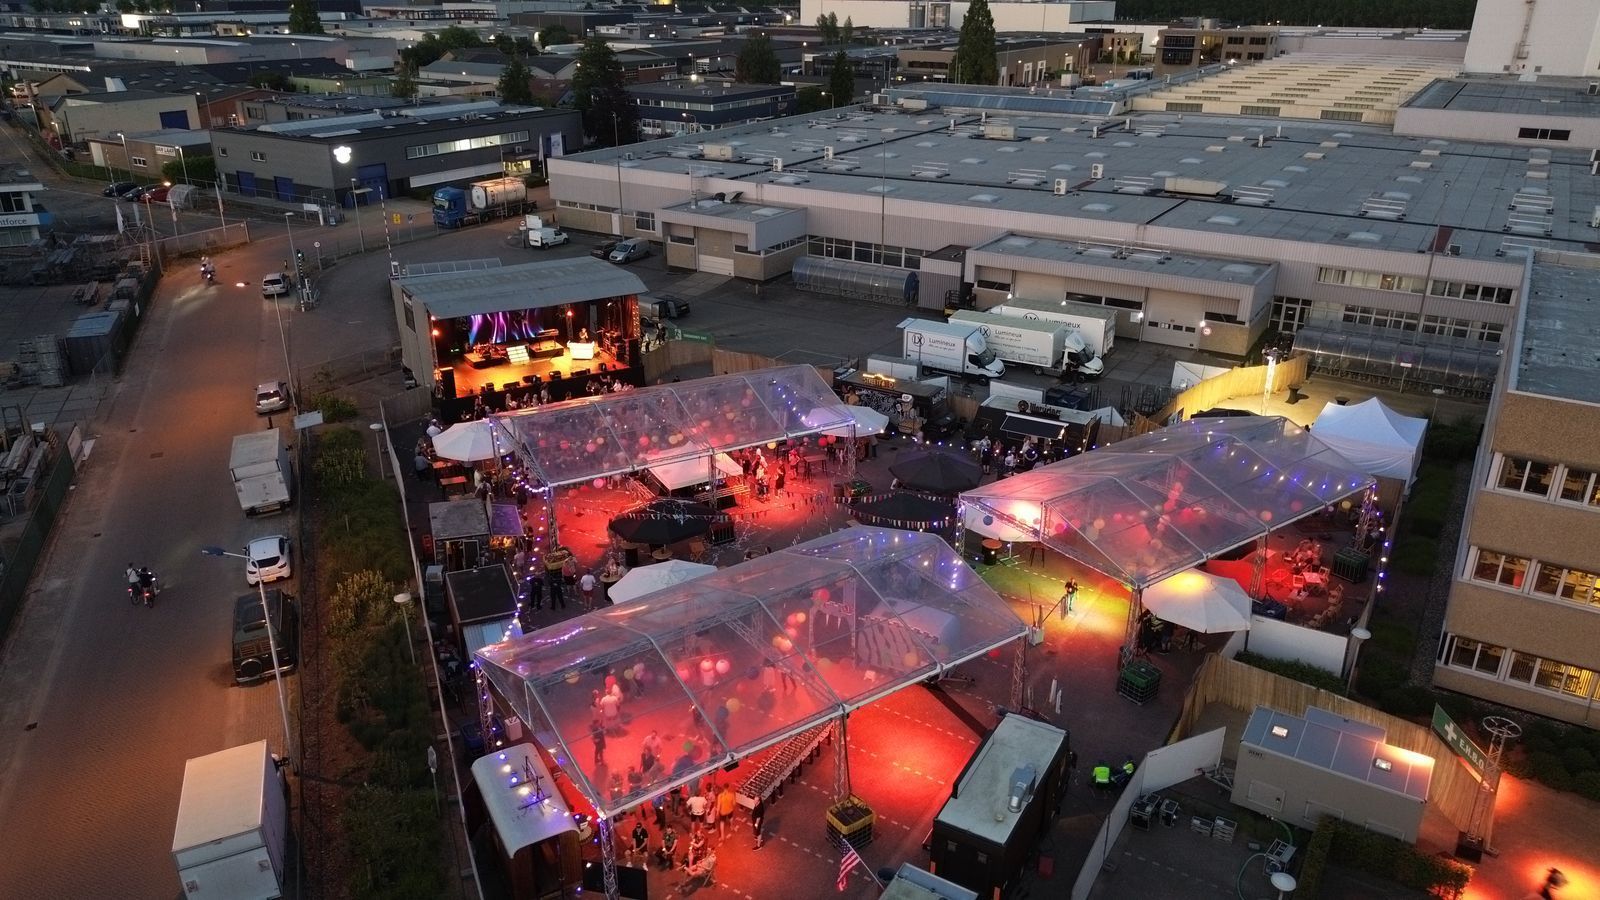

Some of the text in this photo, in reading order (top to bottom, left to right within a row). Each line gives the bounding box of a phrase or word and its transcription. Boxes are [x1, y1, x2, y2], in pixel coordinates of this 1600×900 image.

[1045, 317, 1081, 329] Lmineux
[995, 329, 1022, 338] Lumineux
[928, 337, 956, 347] Lumineux
